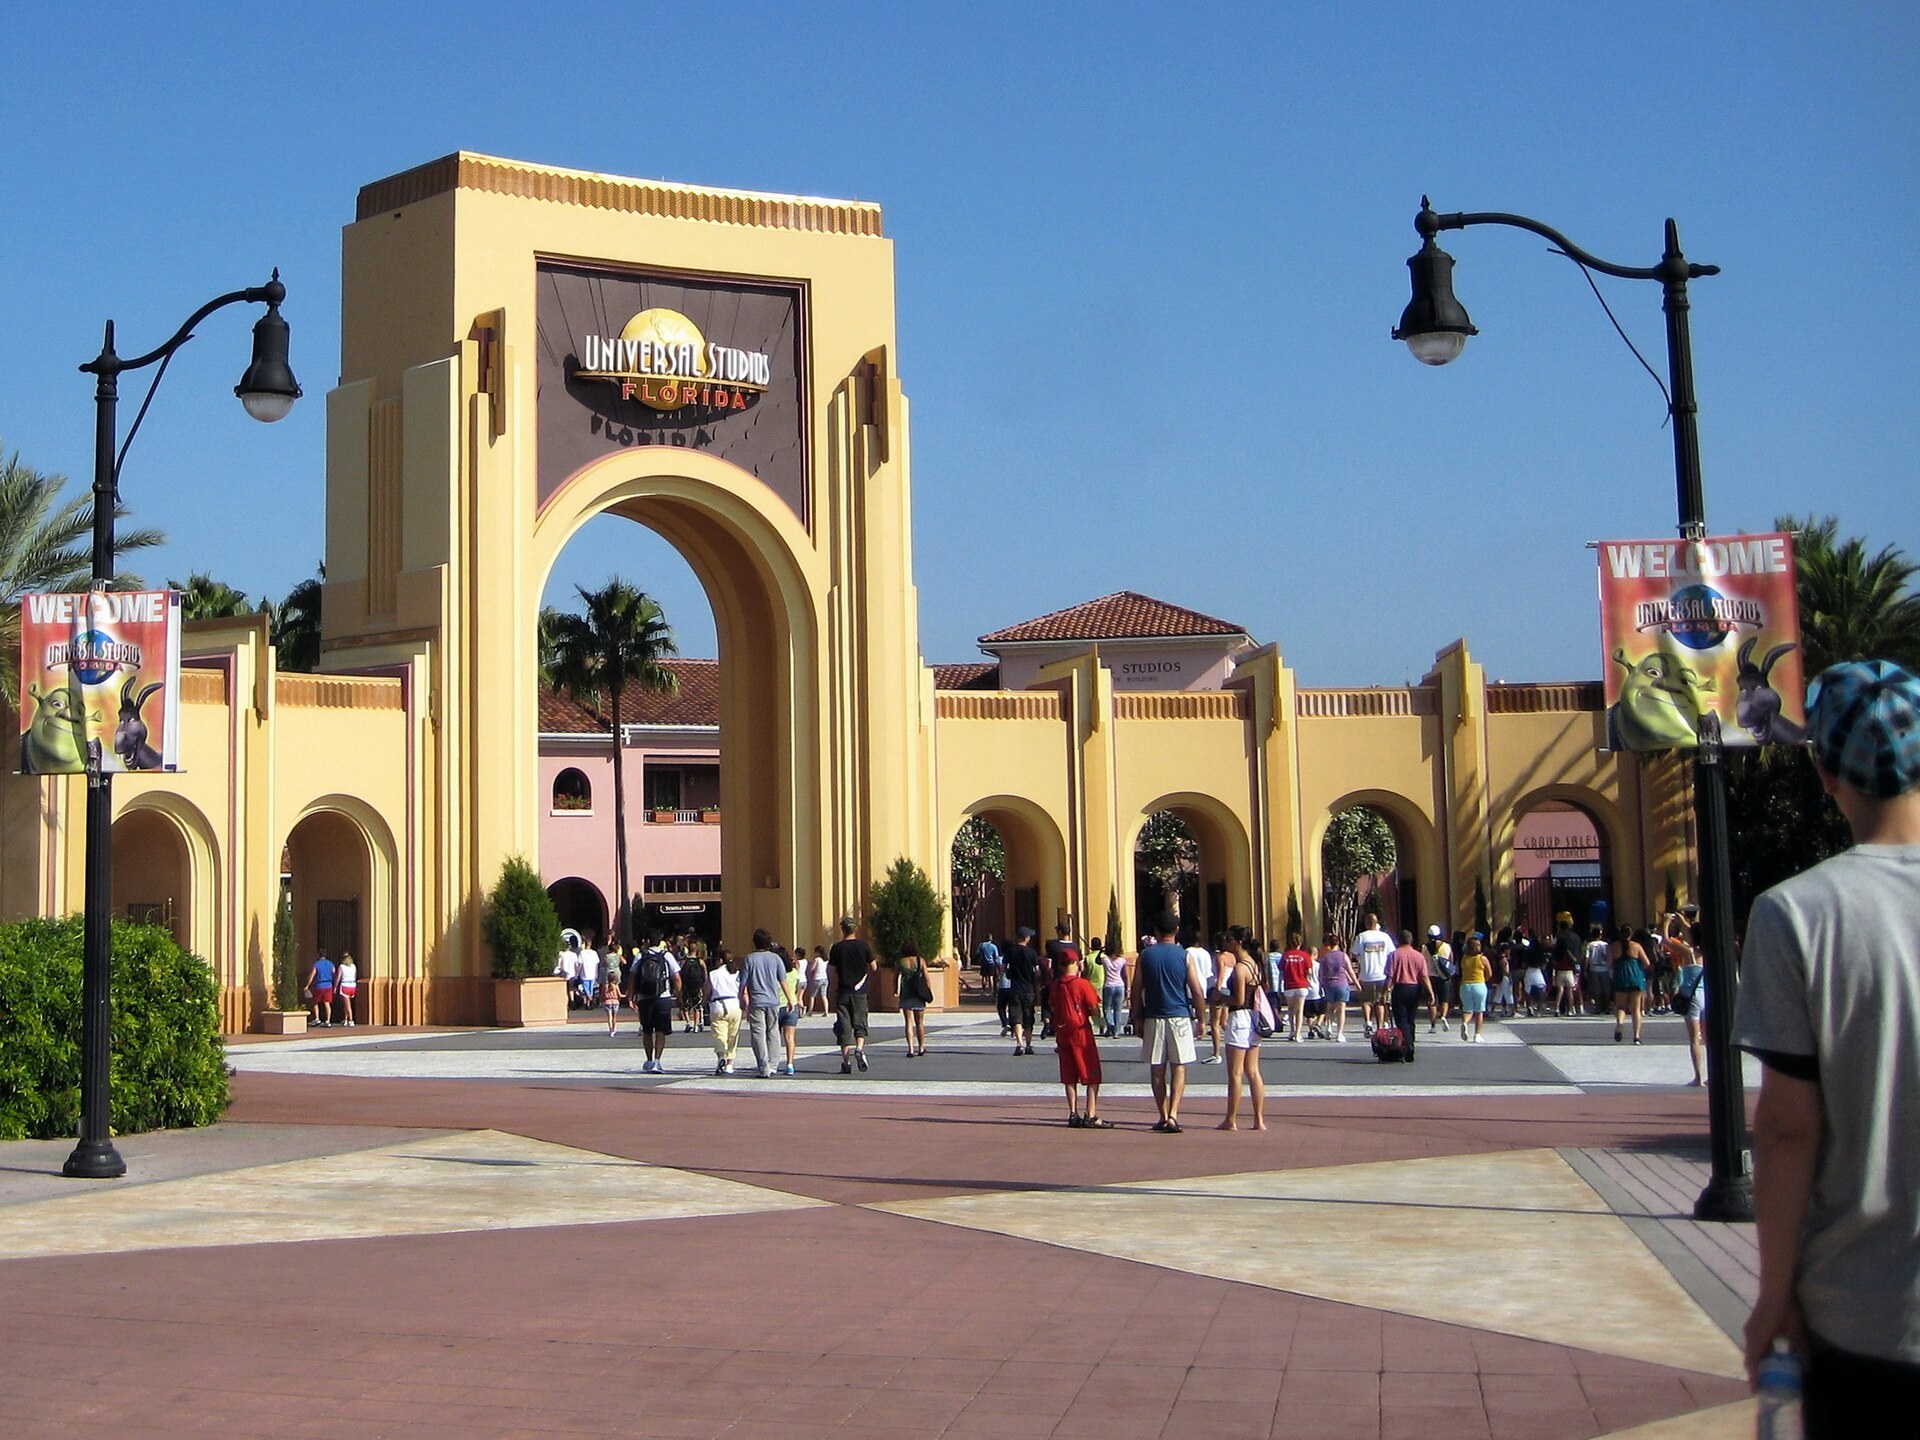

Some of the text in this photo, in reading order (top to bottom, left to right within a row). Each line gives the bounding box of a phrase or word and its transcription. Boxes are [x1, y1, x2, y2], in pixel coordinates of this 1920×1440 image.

[585, 335, 770, 385] UNIVERSAL STUDIOS
[622, 384, 746, 409] FLORIDA
[1607, 539, 1787, 578] WELCOME
[29, 593, 164, 624] WELCOME
[1636, 597, 1763, 625] UNIVERSAL STUDIOS
[48, 641, 142, 663] UNIVERSAL STUDIOS
[1122, 661, 1181, 674] STUDIOS
[1523, 835, 1598, 848] GROUP SALES
